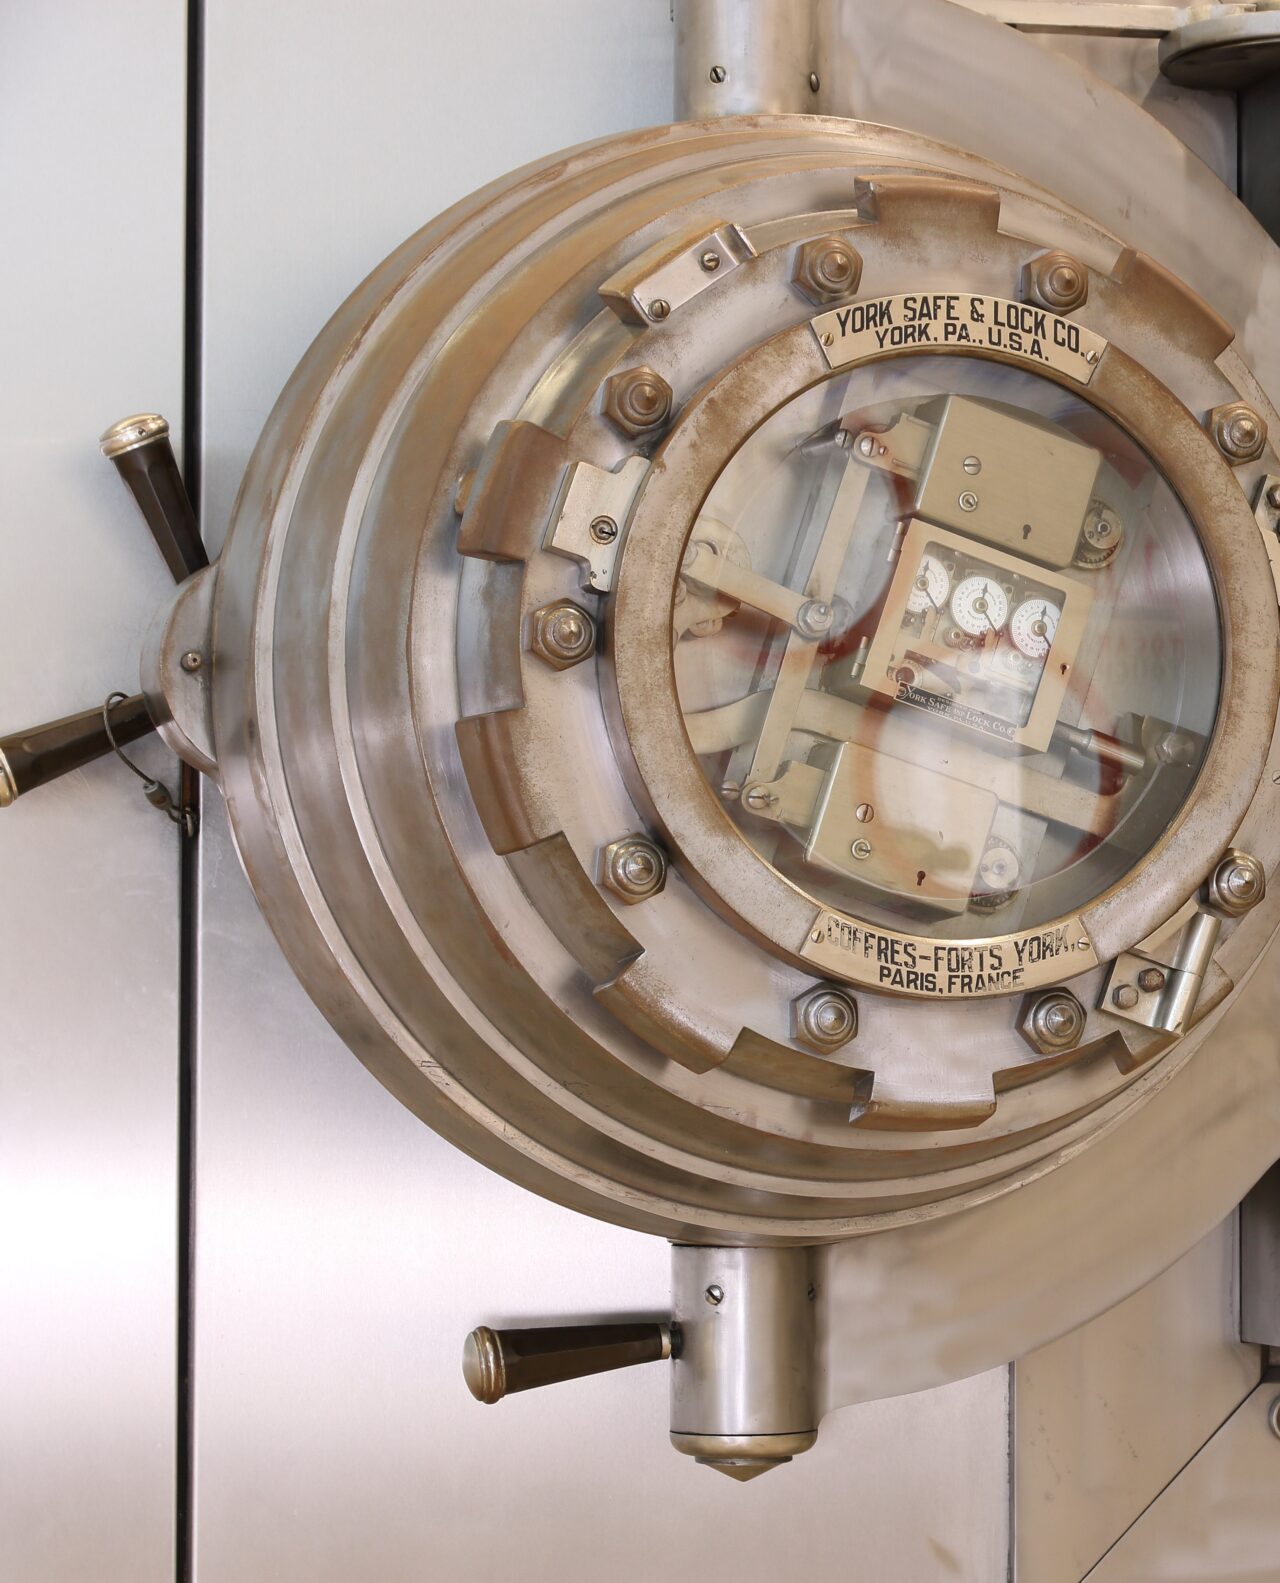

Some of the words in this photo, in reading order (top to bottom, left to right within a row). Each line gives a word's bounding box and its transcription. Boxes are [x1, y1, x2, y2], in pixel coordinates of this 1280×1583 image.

[836, 299, 893, 337] YORK
[903, 296, 960, 323] SAFE
[970, 298, 985, 323] &
[993, 301, 1047, 340] LOCK
[1053, 319, 1086, 357] CO.
[875, 323, 938, 349] YORK,
[947, 967, 1025, 994] FRANCE
